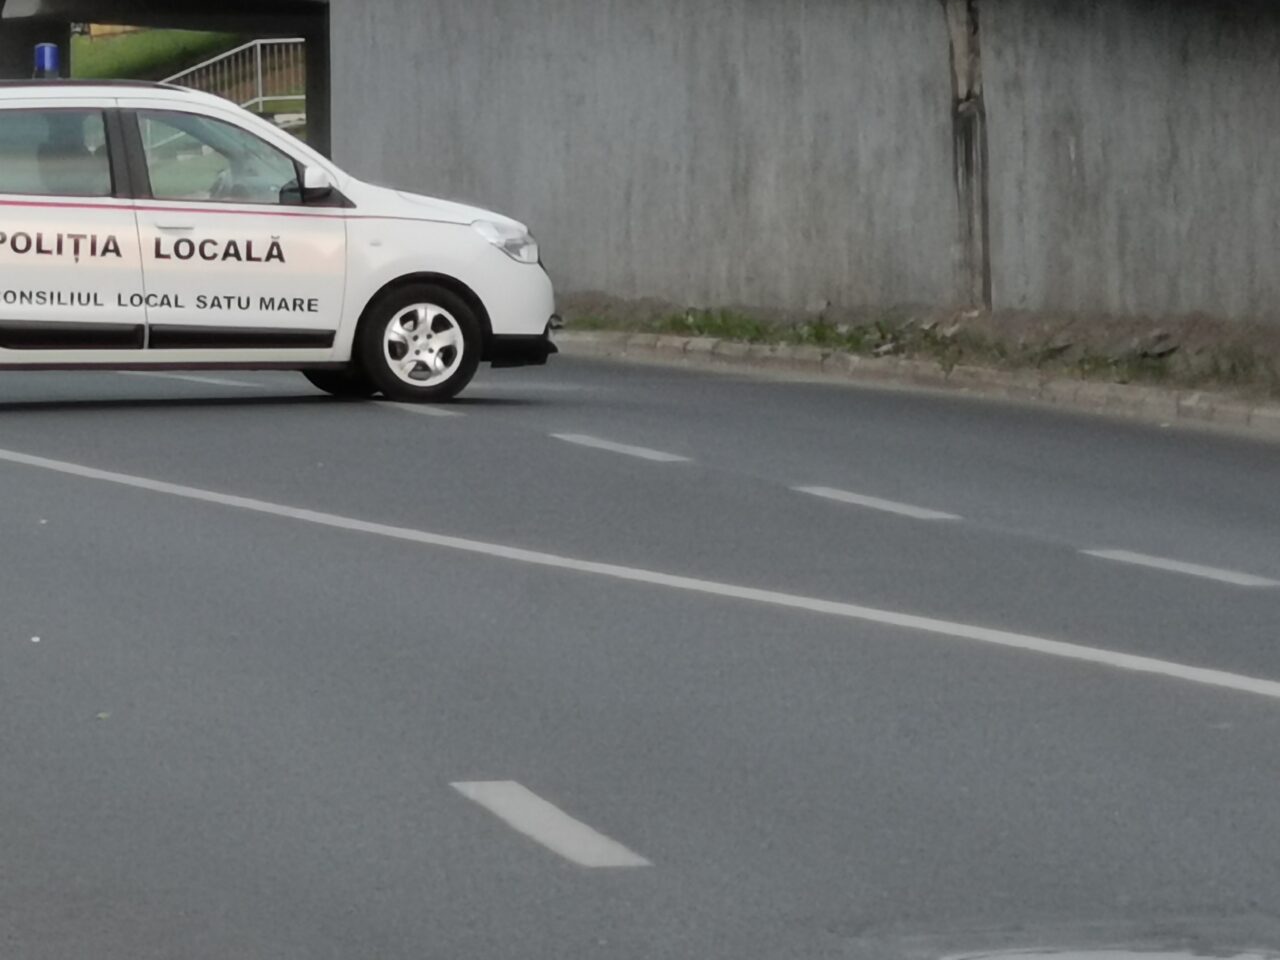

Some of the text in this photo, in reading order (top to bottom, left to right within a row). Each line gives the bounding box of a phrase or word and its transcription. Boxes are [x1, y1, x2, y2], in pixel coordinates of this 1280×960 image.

[154, 236, 286, 263] LOCALĂ
[117, 293, 185, 309] LOCAL
[195, 295, 251, 311] SATU
[259, 297, 319, 313] MARE
